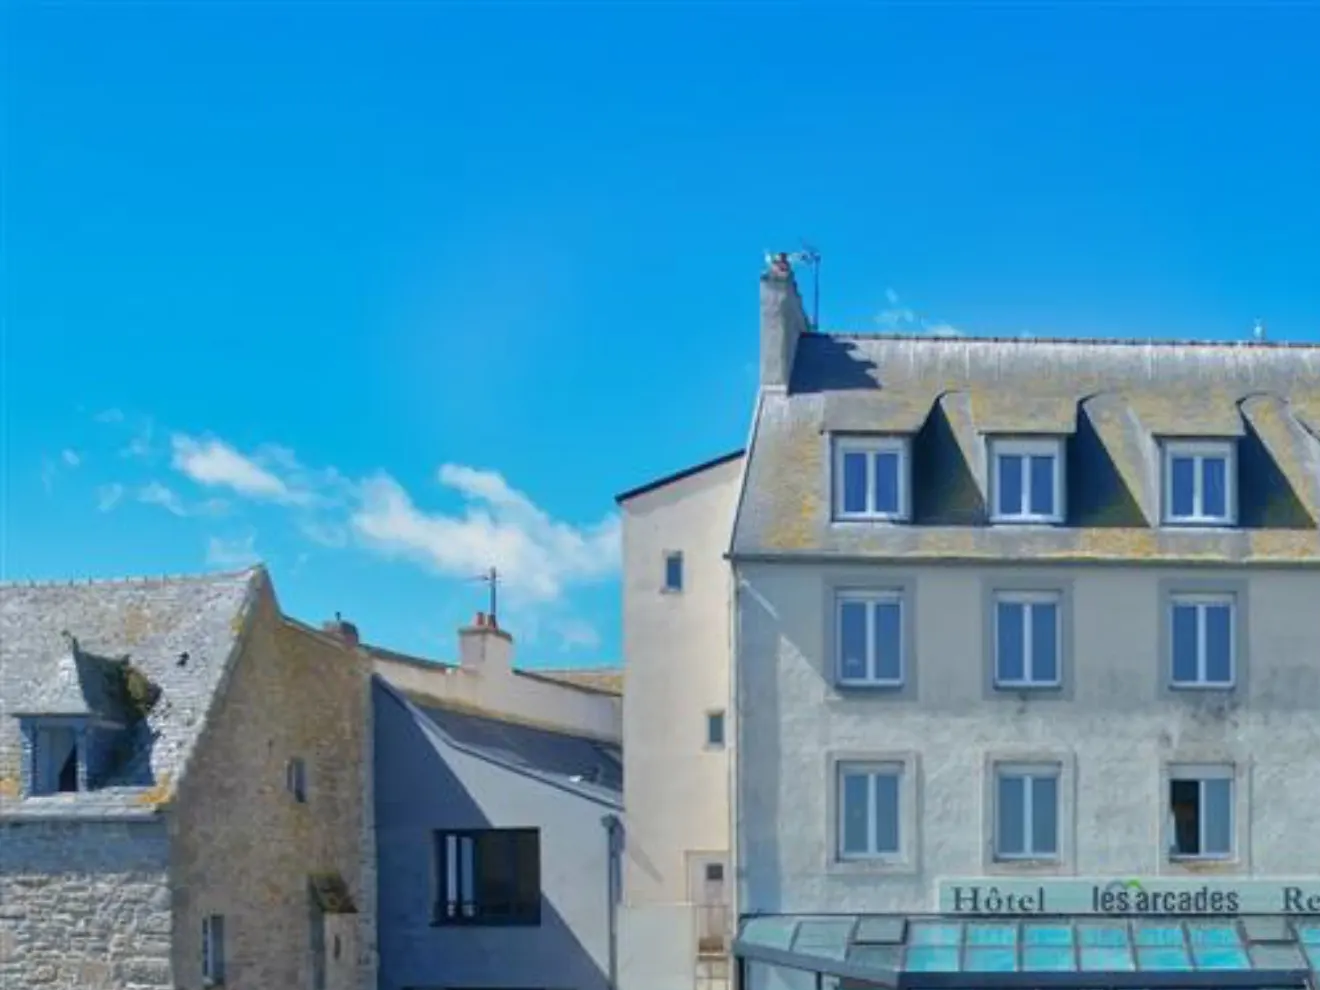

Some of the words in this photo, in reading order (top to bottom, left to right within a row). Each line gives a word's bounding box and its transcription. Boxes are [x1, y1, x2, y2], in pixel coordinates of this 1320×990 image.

[952, 886, 1045, 912] Hôtel
[1092, 886, 1129, 912] les
[1135, 886, 1239, 912] arcades
